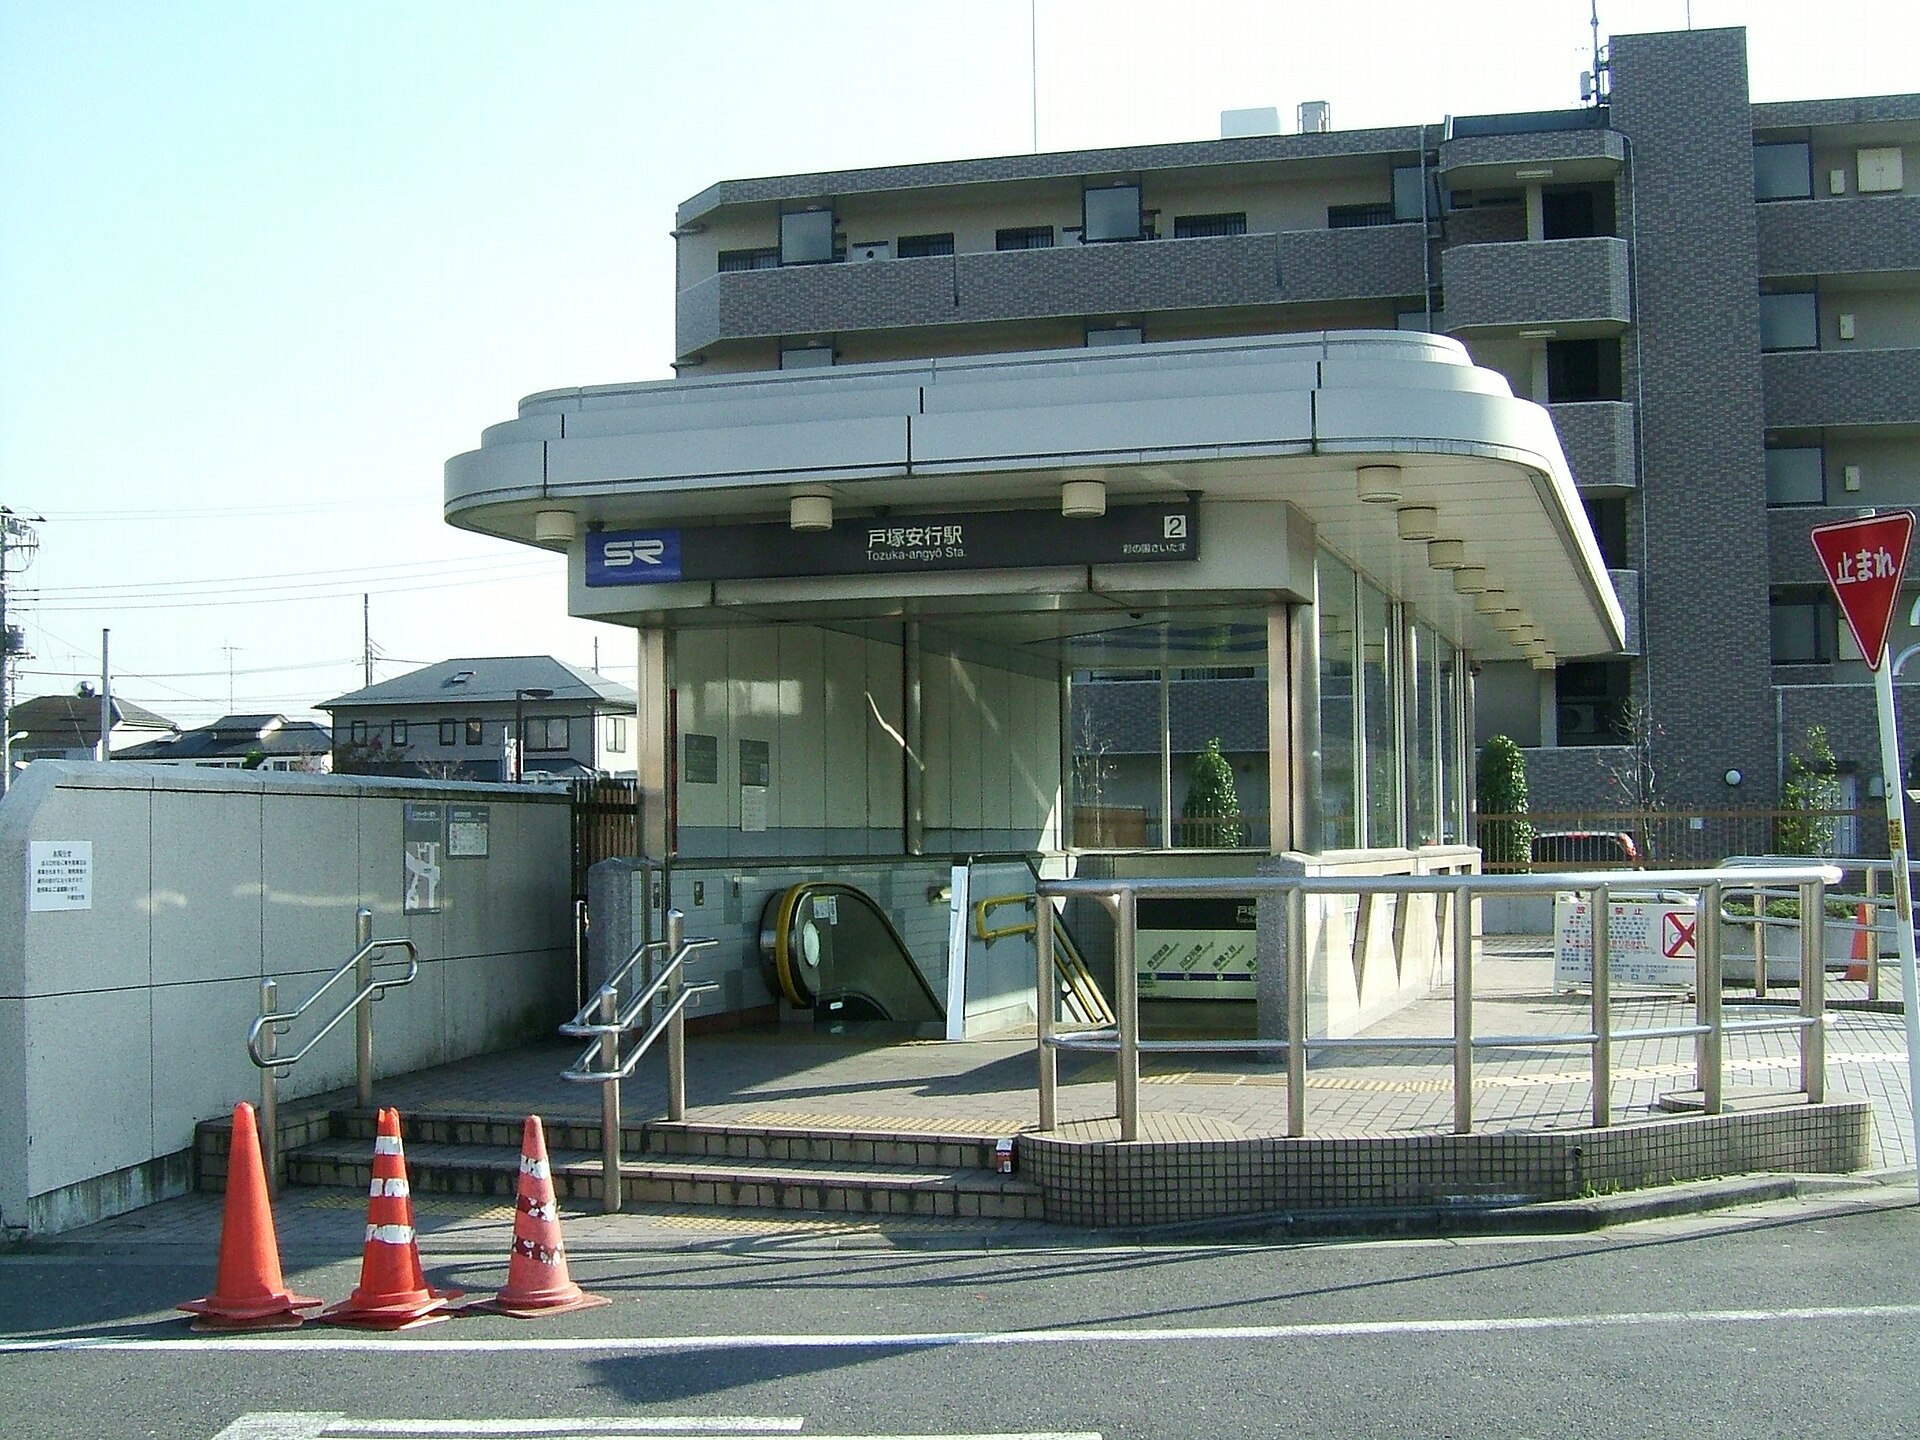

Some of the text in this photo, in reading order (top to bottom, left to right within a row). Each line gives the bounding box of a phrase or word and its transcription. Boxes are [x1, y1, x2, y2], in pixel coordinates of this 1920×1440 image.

[867, 525, 963, 548] 戸塚安行駅
[1169, 517, 1182, 536] 2
[603, 539, 665, 567] SR
[945, 546, 968, 558] Sta.
[1122, 542, 1187, 554] 彩の国さいたま
[1836, 546, 1896, 585] 止まれ
